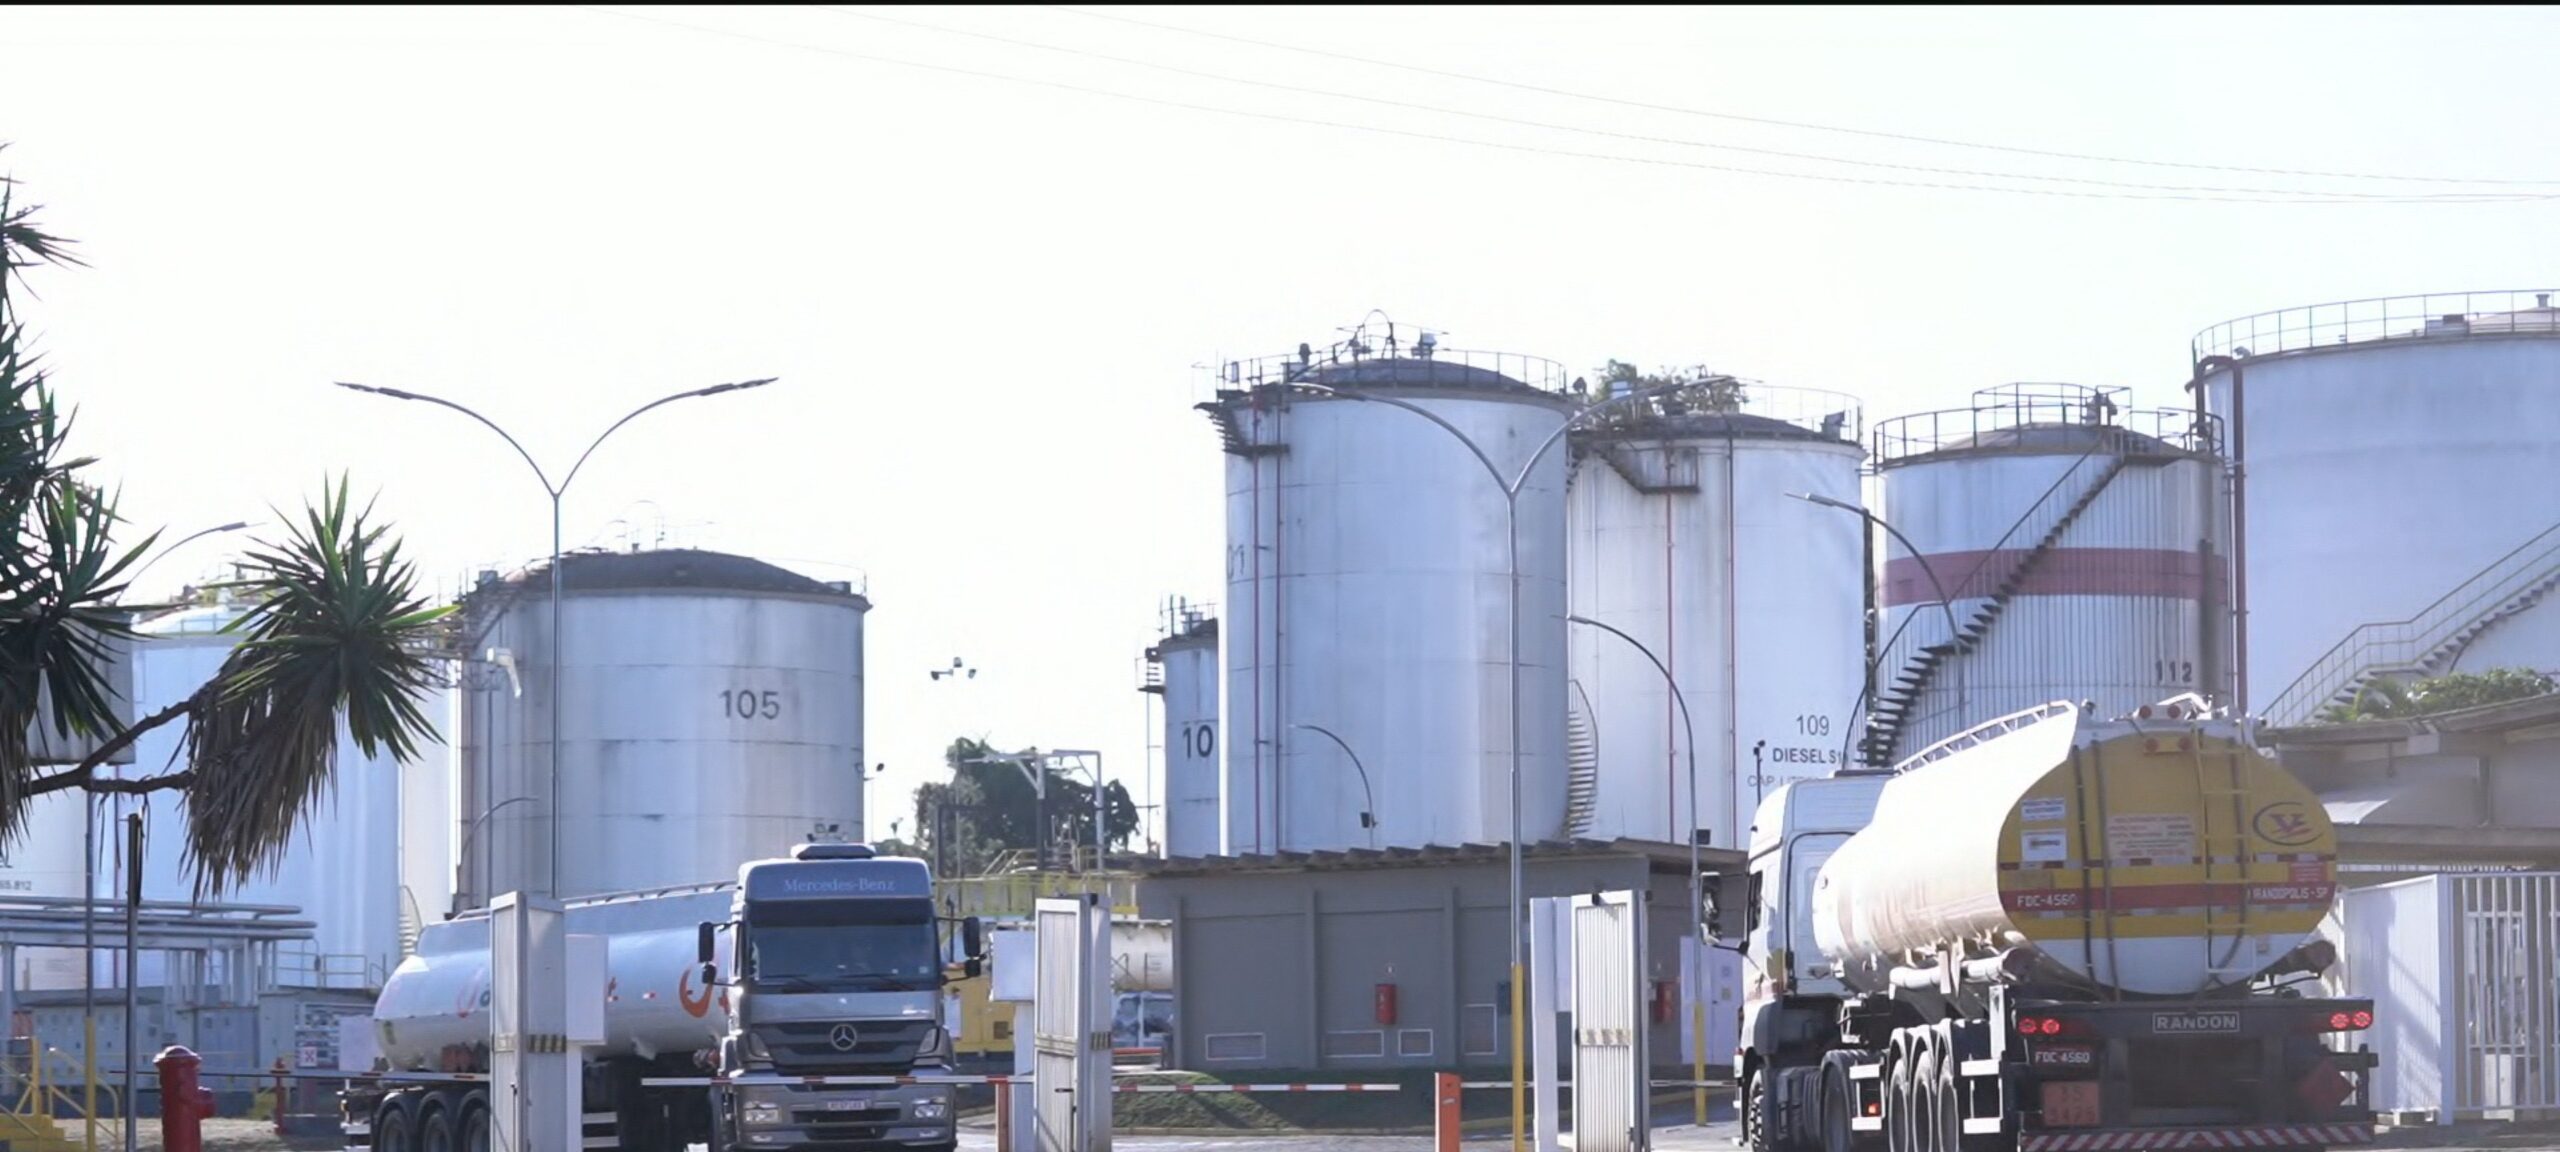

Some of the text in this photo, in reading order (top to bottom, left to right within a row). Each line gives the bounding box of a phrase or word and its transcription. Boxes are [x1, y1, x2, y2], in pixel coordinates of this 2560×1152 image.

[2154, 660, 2192, 682] 112
[718, 689, 781, 720] 105
[1796, 714, 1830, 736] 109
[1772, 747, 1826, 764] DIESEL
[783, 878, 896, 893] Mercedes-Benz
[2157, 1015, 2236, 1029] RANDON
